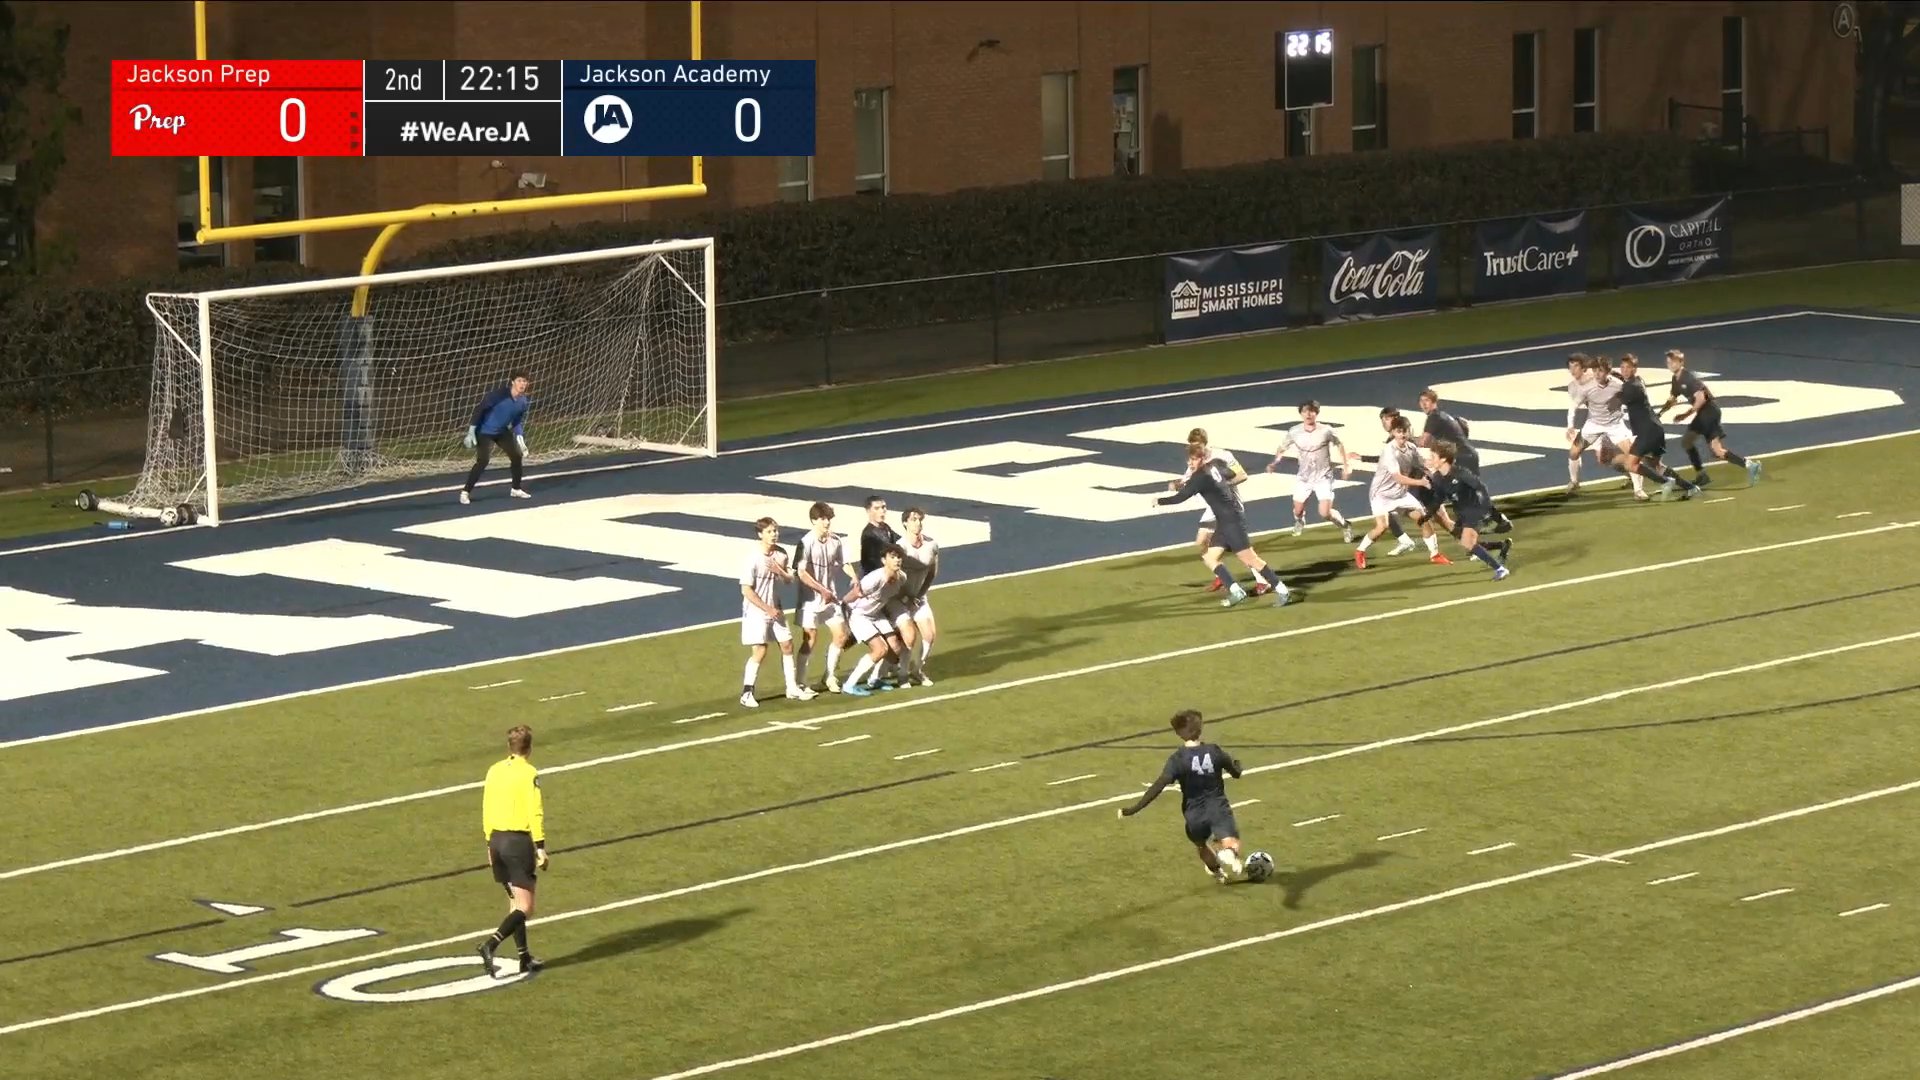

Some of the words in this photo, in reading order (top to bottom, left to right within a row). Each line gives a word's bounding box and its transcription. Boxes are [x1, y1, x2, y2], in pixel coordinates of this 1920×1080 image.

[1669, 217, 1722, 239] CAPITAL
[1329, 248, 1431, 304] Coca-Cola
[1202, 278, 1283, 300] MISSISSIPPI
[1174, 297, 1197, 310] MSH
[1201, 297, 1240, 313] SMART
[1242, 292, 1284, 309] HOMES
[1191, 752, 1215, 775] 44
